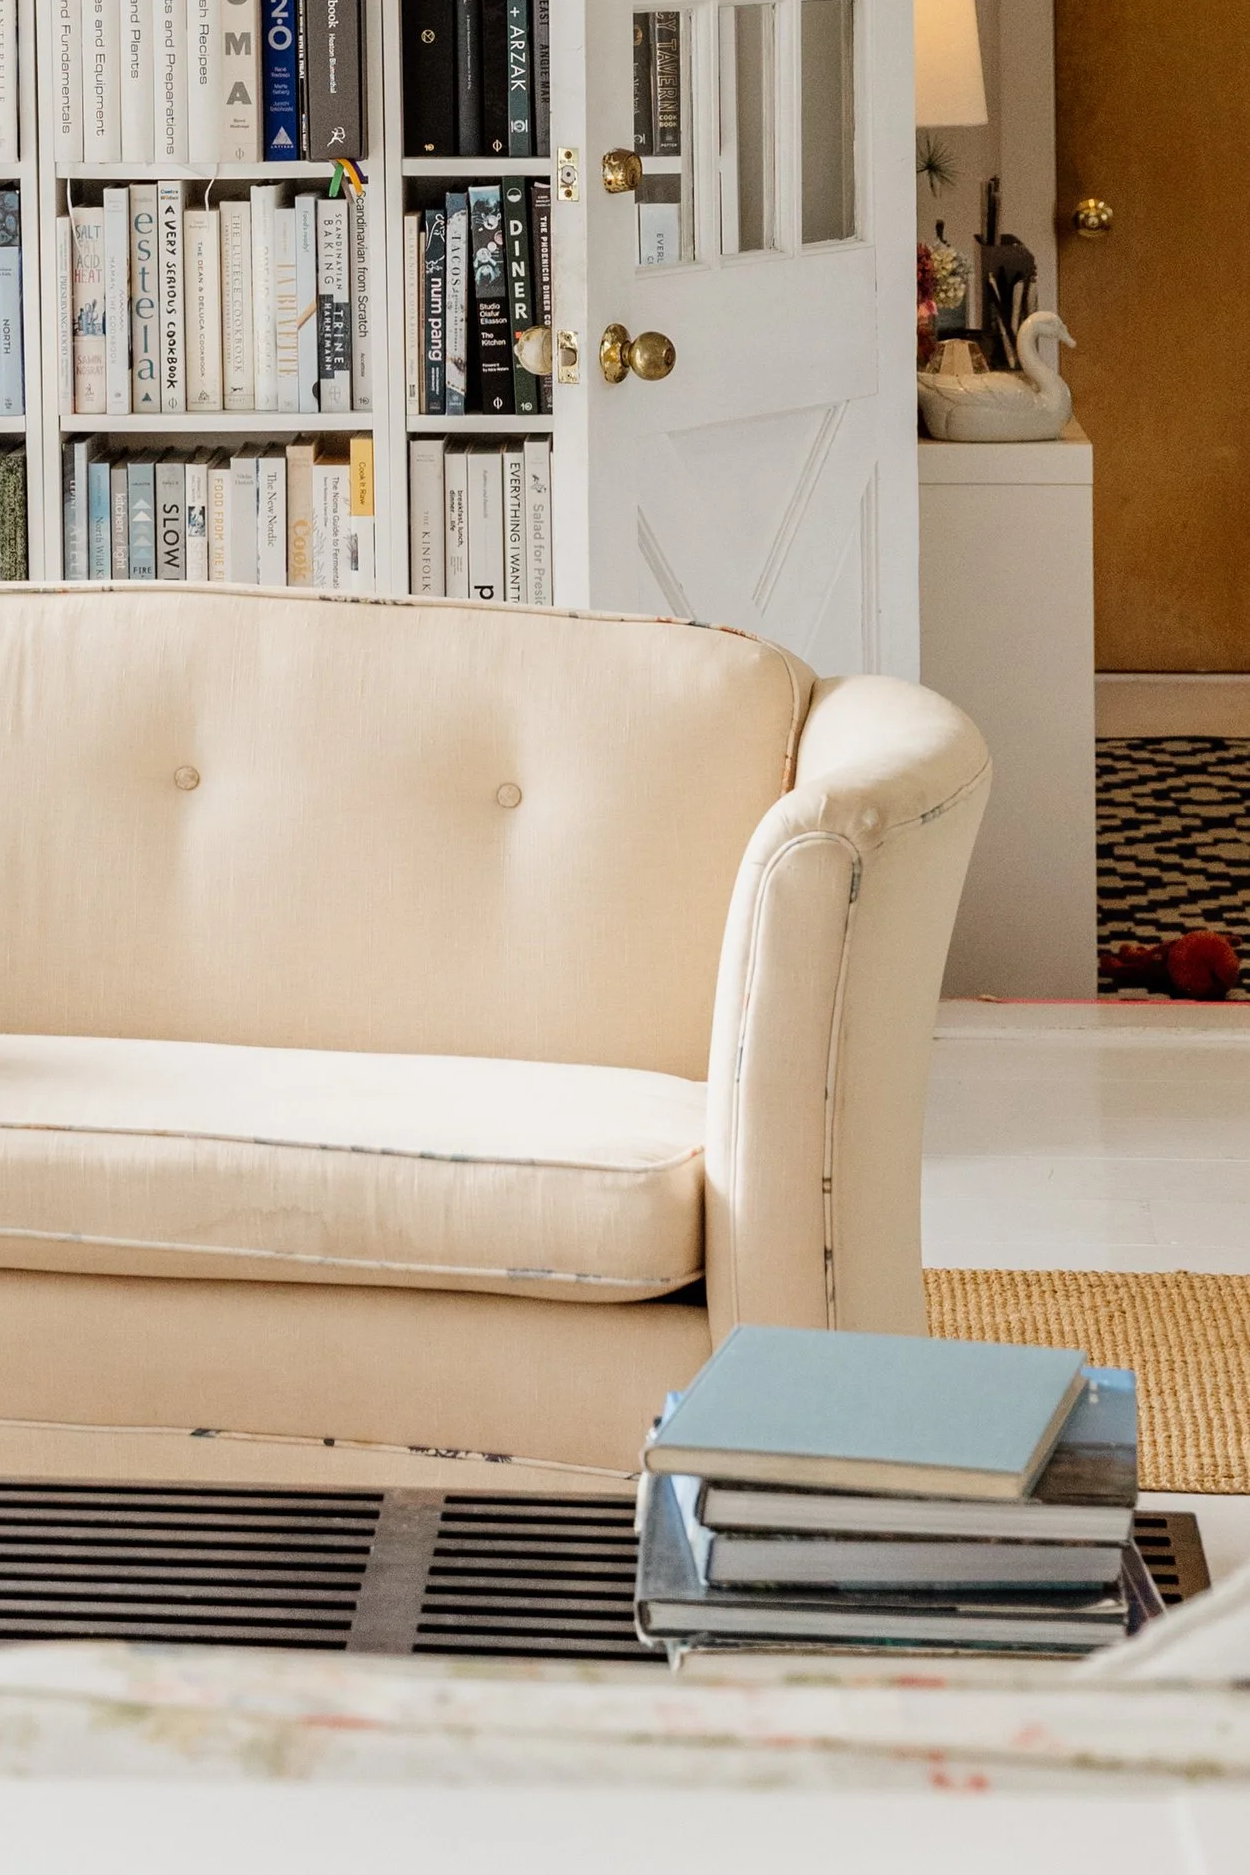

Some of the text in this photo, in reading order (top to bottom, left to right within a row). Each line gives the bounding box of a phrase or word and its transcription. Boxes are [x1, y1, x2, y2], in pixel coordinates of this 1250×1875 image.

[94, 19, 105, 47] and
[130, 29, 142, 79] Plants
[164, 20, 176, 48] and
[196, 24, 212, 85] Recipes
[540, 43, 551, 78] ANGIE
[60, 25, 74, 134] Fundamentals
[94, 53, 109, 137] Equipment
[163, 53, 178, 155] Preparations
[329, 57, 338, 94] Blumenthal
[540, 82, 551, 105] MAR
[656, 39, 678, 112] TAVERN
[323, 218, 334, 286] BAKING
[335, 212, 344, 291] SCANDINAVIAN
[133, 212, 157, 381] estela
[428, 277, 444, 362] num pang
[3, 318, 12, 355] NORTH
[324, 302, 333, 371] HAHNEMANN
[333, 309, 344, 365] TRINE
[95, 516, 106, 565] North Wild
[163, 503, 180, 569] SLOW
[267, 472, 278, 548] The New Nordic
[331, 476, 340, 548] The Noma Guide to
[532, 503, 545, 563] Salad for
[422, 531, 432, 592] KINFOLK
